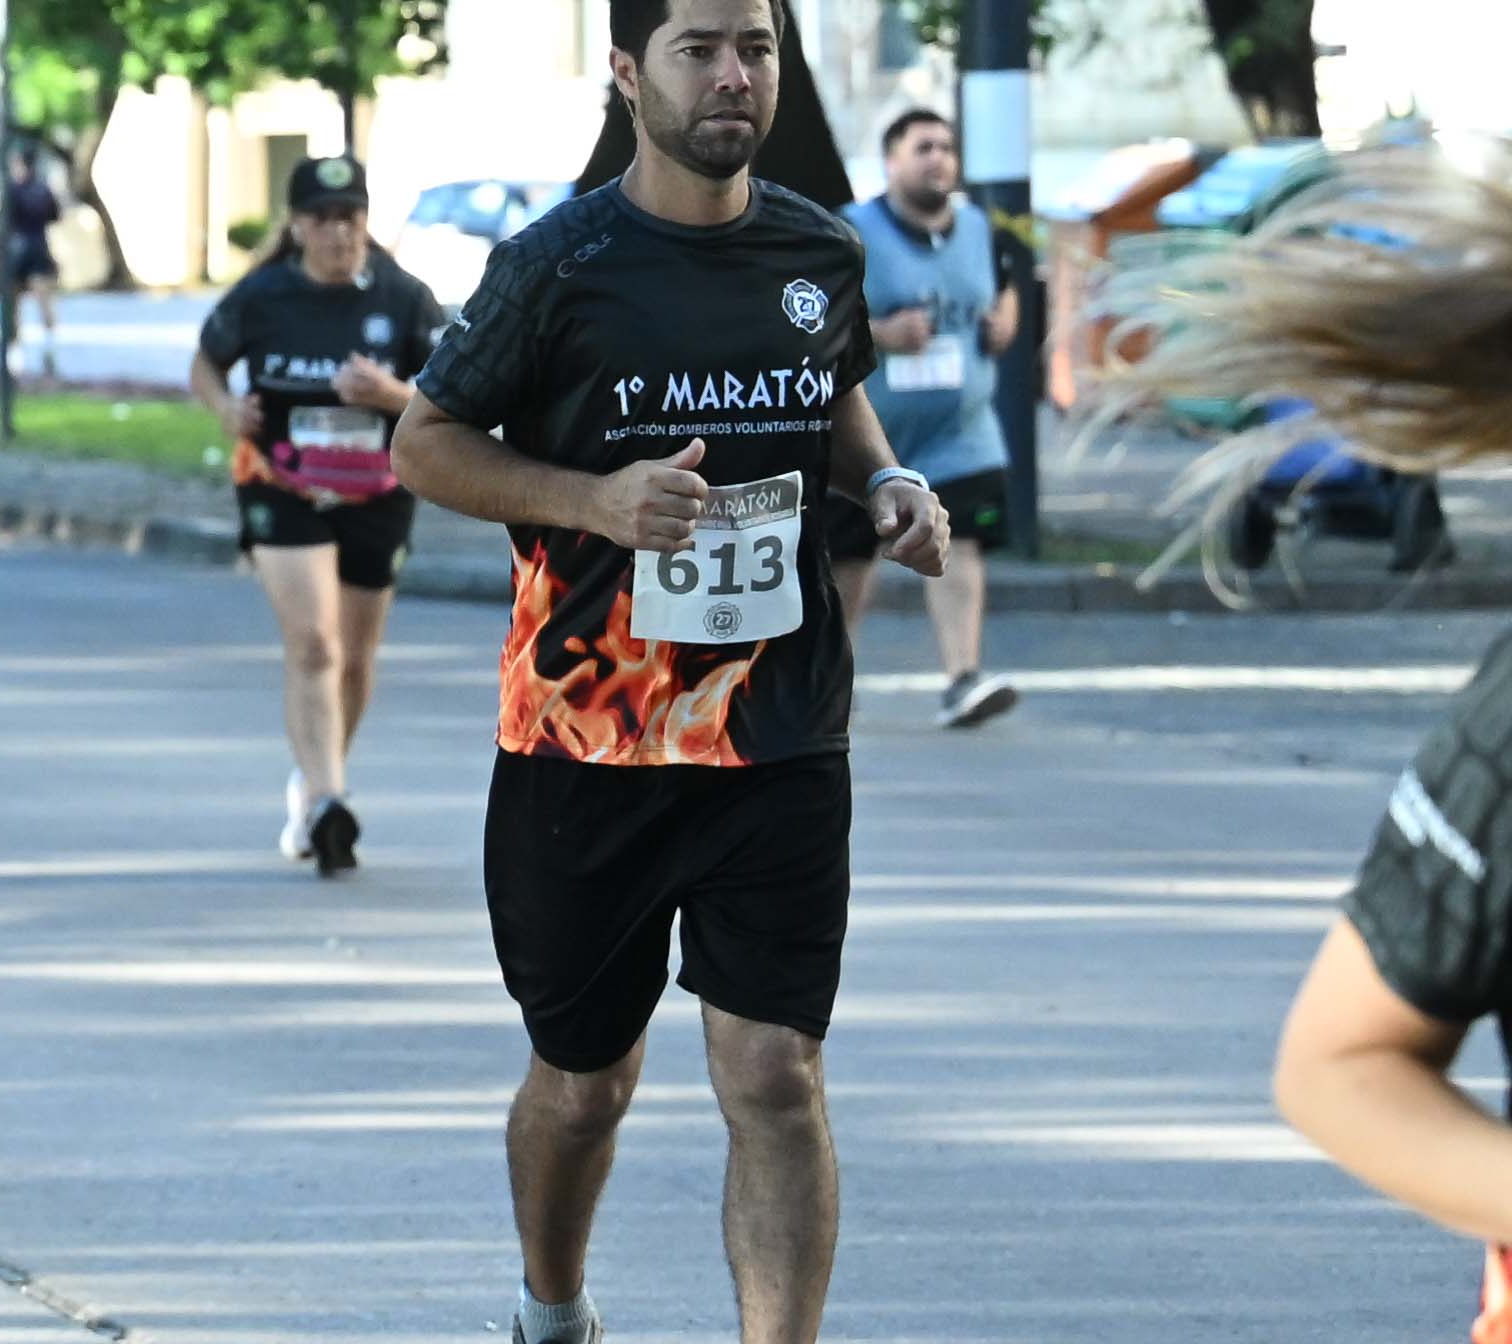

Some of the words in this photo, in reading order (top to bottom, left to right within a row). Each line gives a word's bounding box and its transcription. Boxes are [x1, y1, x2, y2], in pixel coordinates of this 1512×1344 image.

[662, 356, 834, 412] MARATÓN
[669, 421, 731, 436] BOMBEROS
[657, 535, 784, 596] 613
